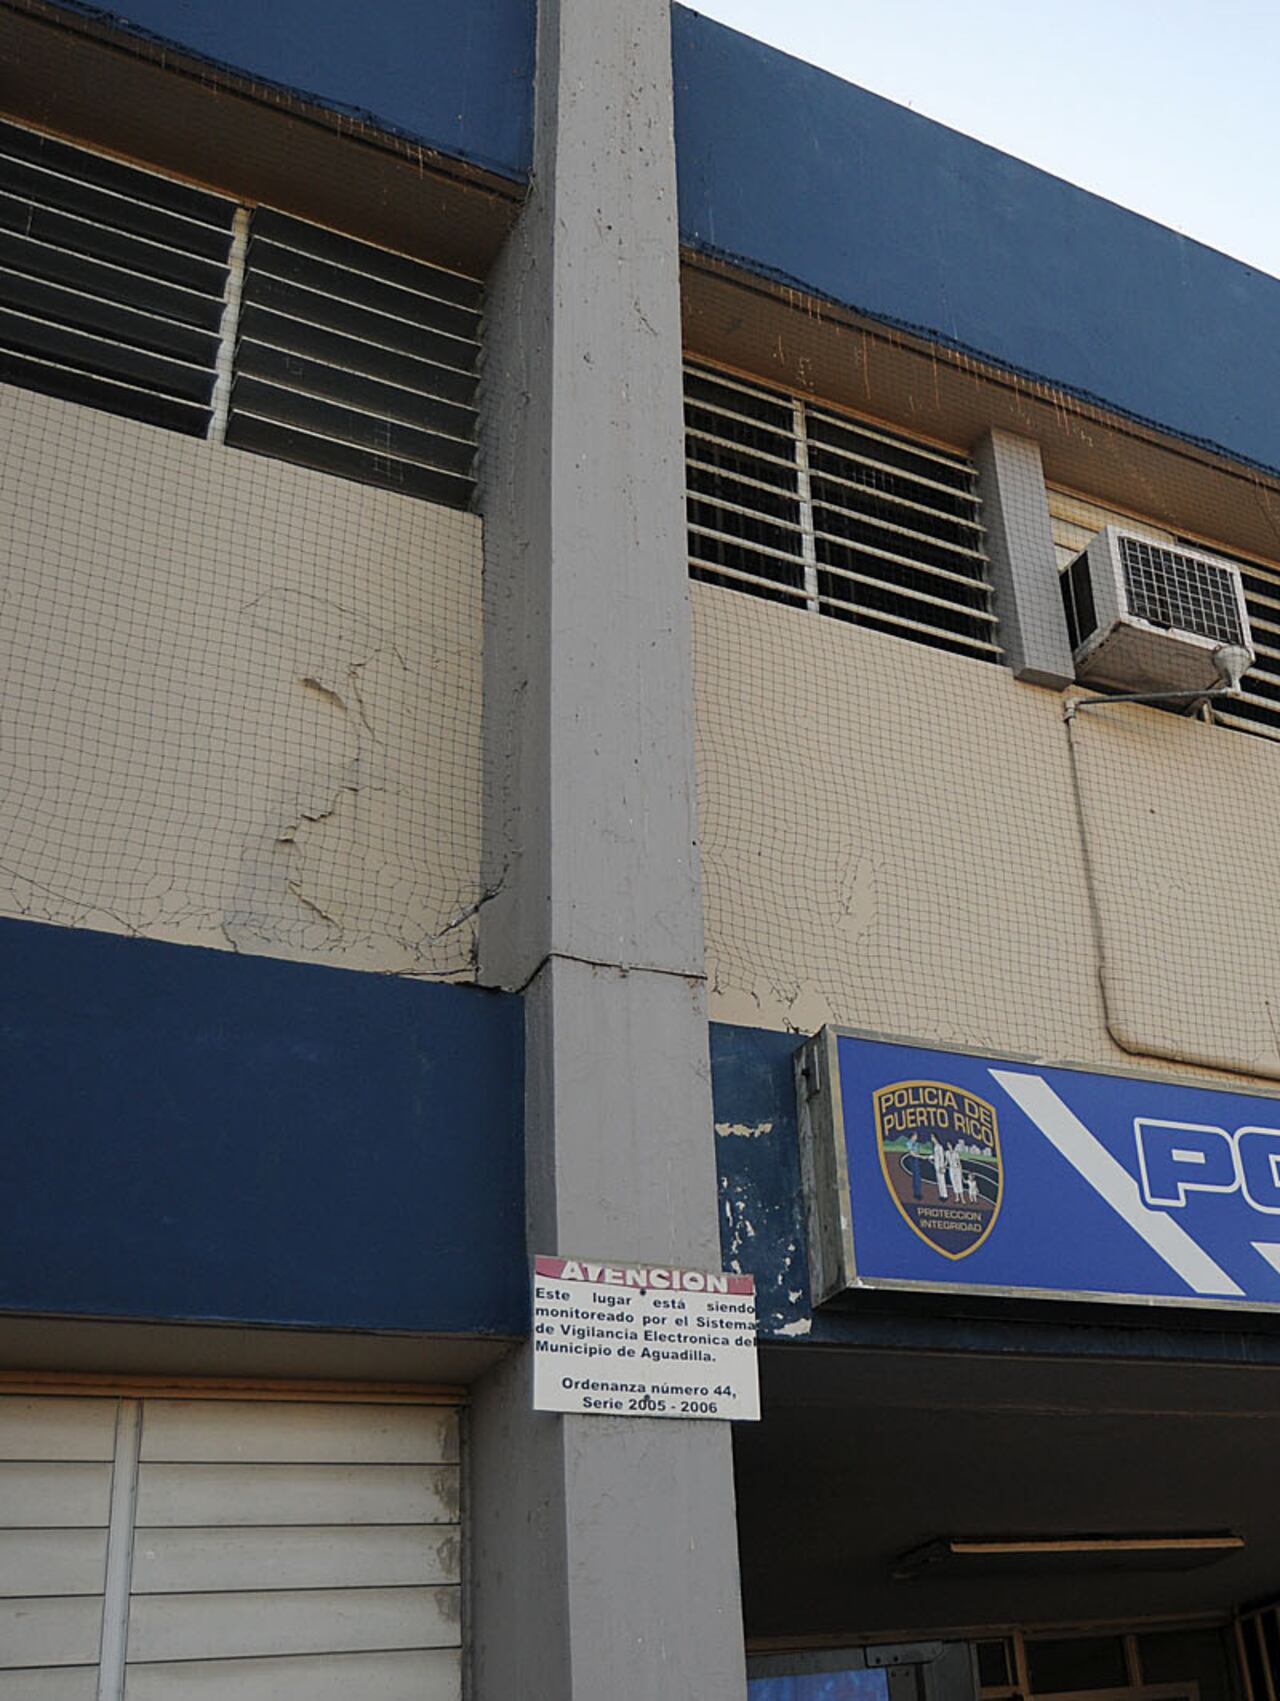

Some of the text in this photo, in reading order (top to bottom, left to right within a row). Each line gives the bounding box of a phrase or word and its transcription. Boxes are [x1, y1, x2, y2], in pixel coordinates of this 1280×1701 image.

[880, 1087, 992, 1128] POLICIA DE
[883, 1107, 994, 1148] PUERTO RICO
[560, 1260, 728, 1293] ATENCION
[535, 1287, 571, 1301] Este
[592, 1292, 632, 1307] lugar
[706, 1301, 756, 1314] siendo
[535, 1307, 757, 1331] monitoreado por el Sistema
[535, 1323, 758, 1347] de Vigilancia Electronica del
[535, 1340, 717, 1362] Municipio de Aguadilla.
[562, 1377, 737, 1399] Ordenanza número 44,
[582, 1396, 624, 1410] Serie
[628, 1399, 667, 1411] 2005
[680, 1401, 718, 1414] 2006
